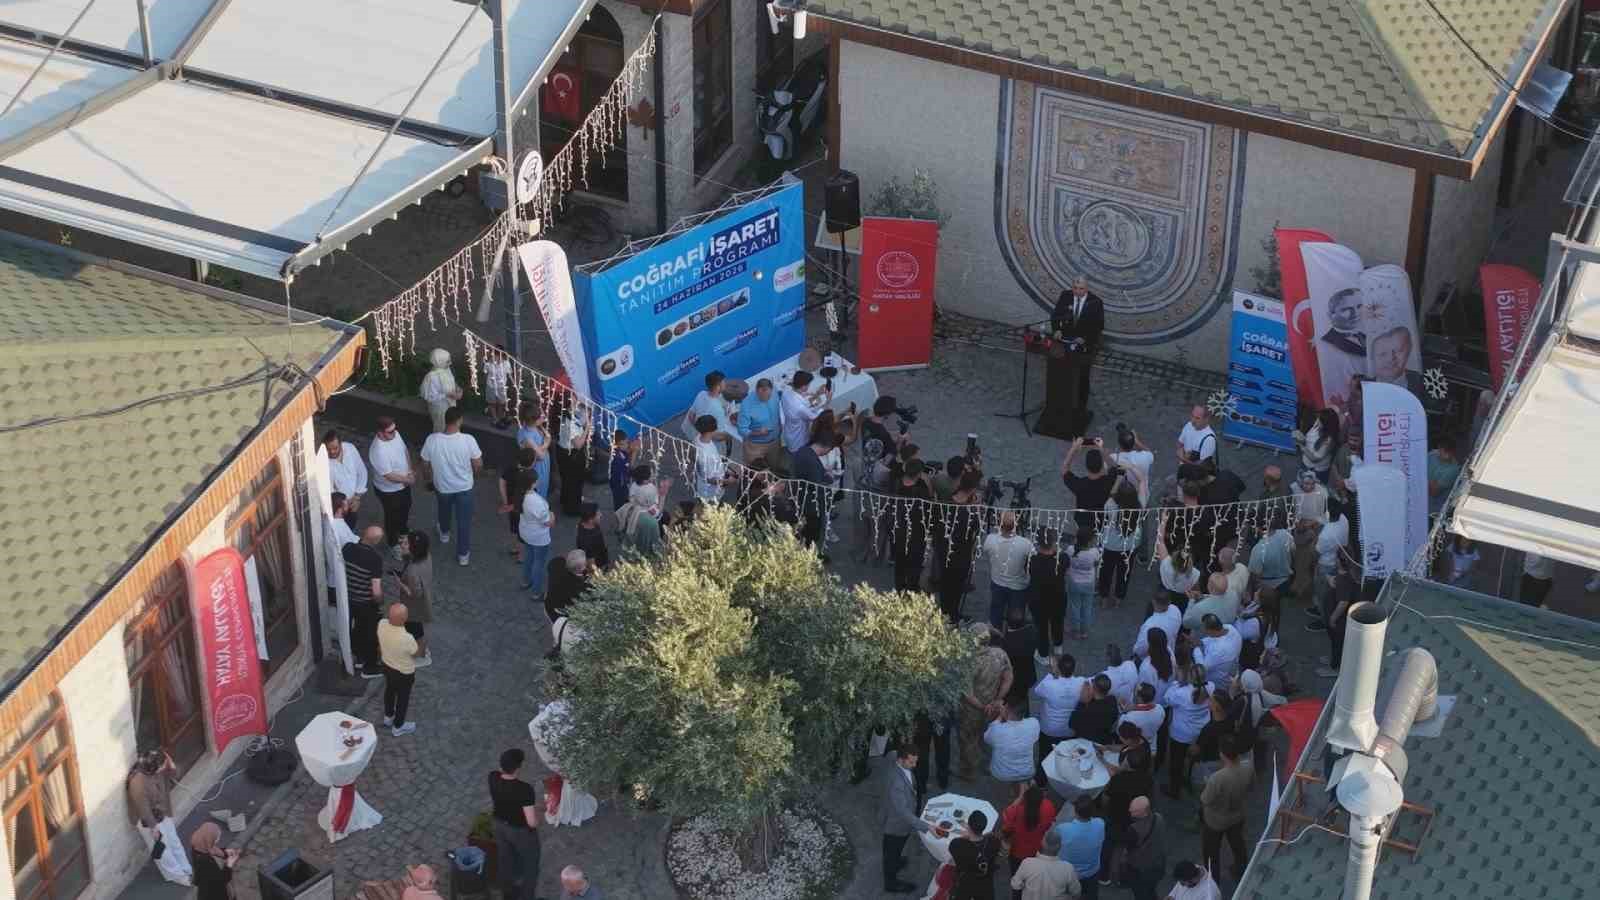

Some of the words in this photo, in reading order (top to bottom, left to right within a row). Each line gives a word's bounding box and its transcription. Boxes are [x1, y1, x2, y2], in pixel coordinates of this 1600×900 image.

[618, 243, 705, 299] COĞRAFİ
[709, 212, 779, 256] İŞARET
[619, 276, 685, 315] TANITIM
[692, 231, 779, 280] PROGRAMI
[1243, 331, 1289, 350] COĞRAF
